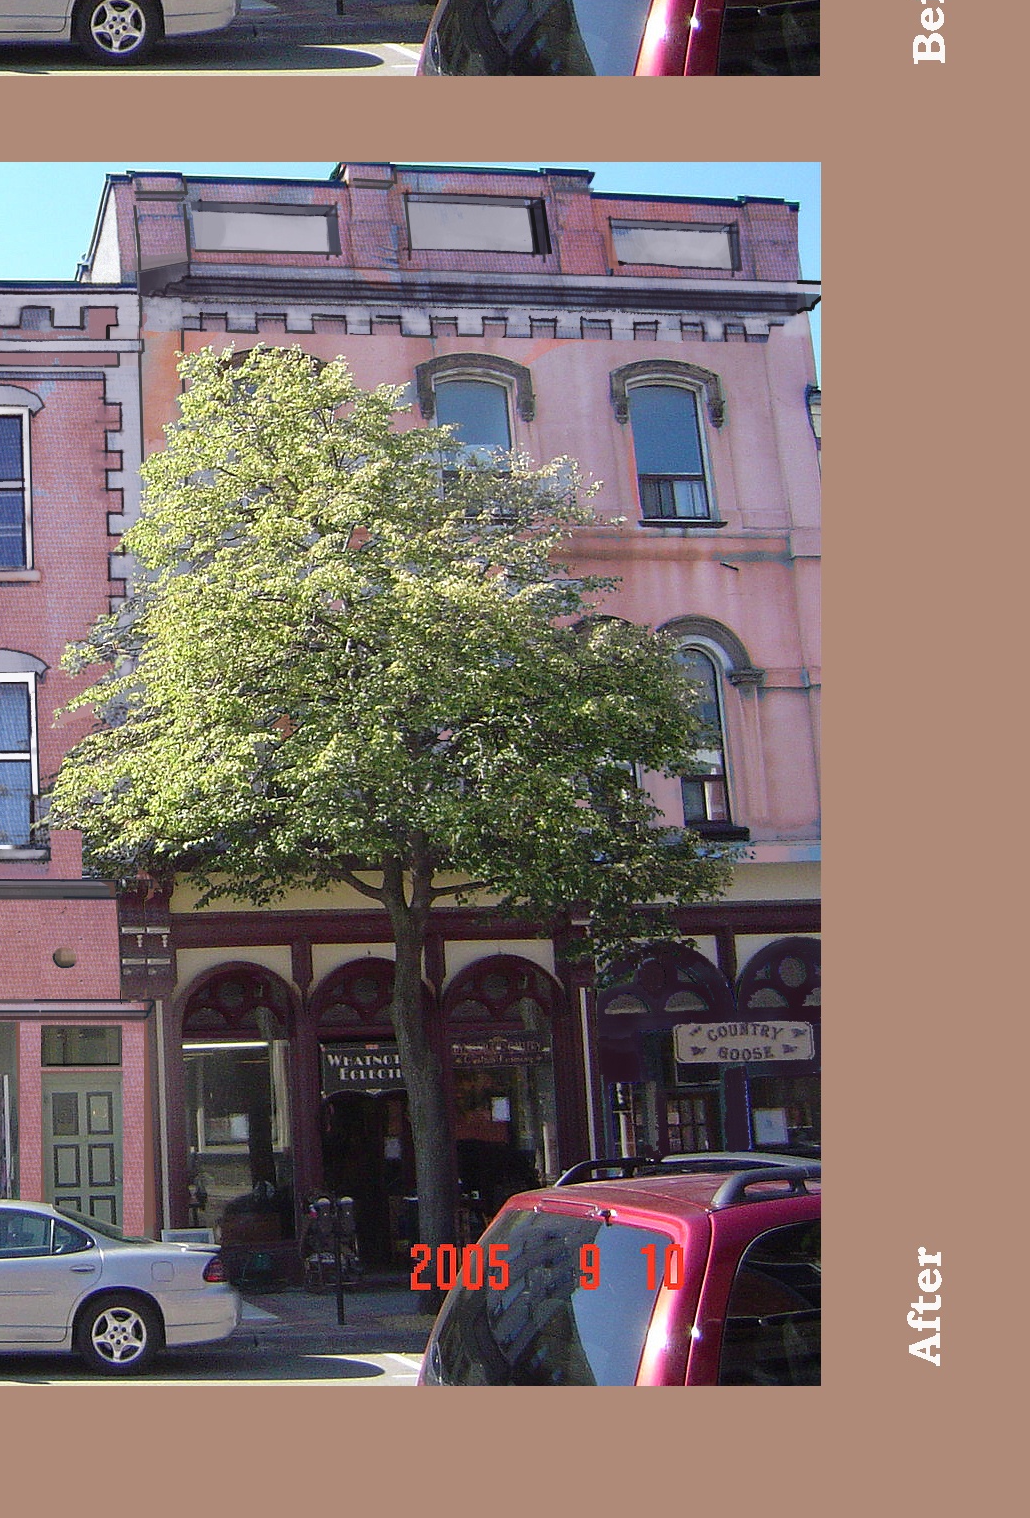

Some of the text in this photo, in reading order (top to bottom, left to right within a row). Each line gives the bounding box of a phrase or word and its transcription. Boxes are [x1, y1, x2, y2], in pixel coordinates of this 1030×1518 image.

[707, 1023, 784, 1042] COUNTRY
[718, 1046, 775, 1060] GOOSE
[328, 1054, 400, 1066] WHATNOT
[340, 1068, 402, 1080] ECLECTI
